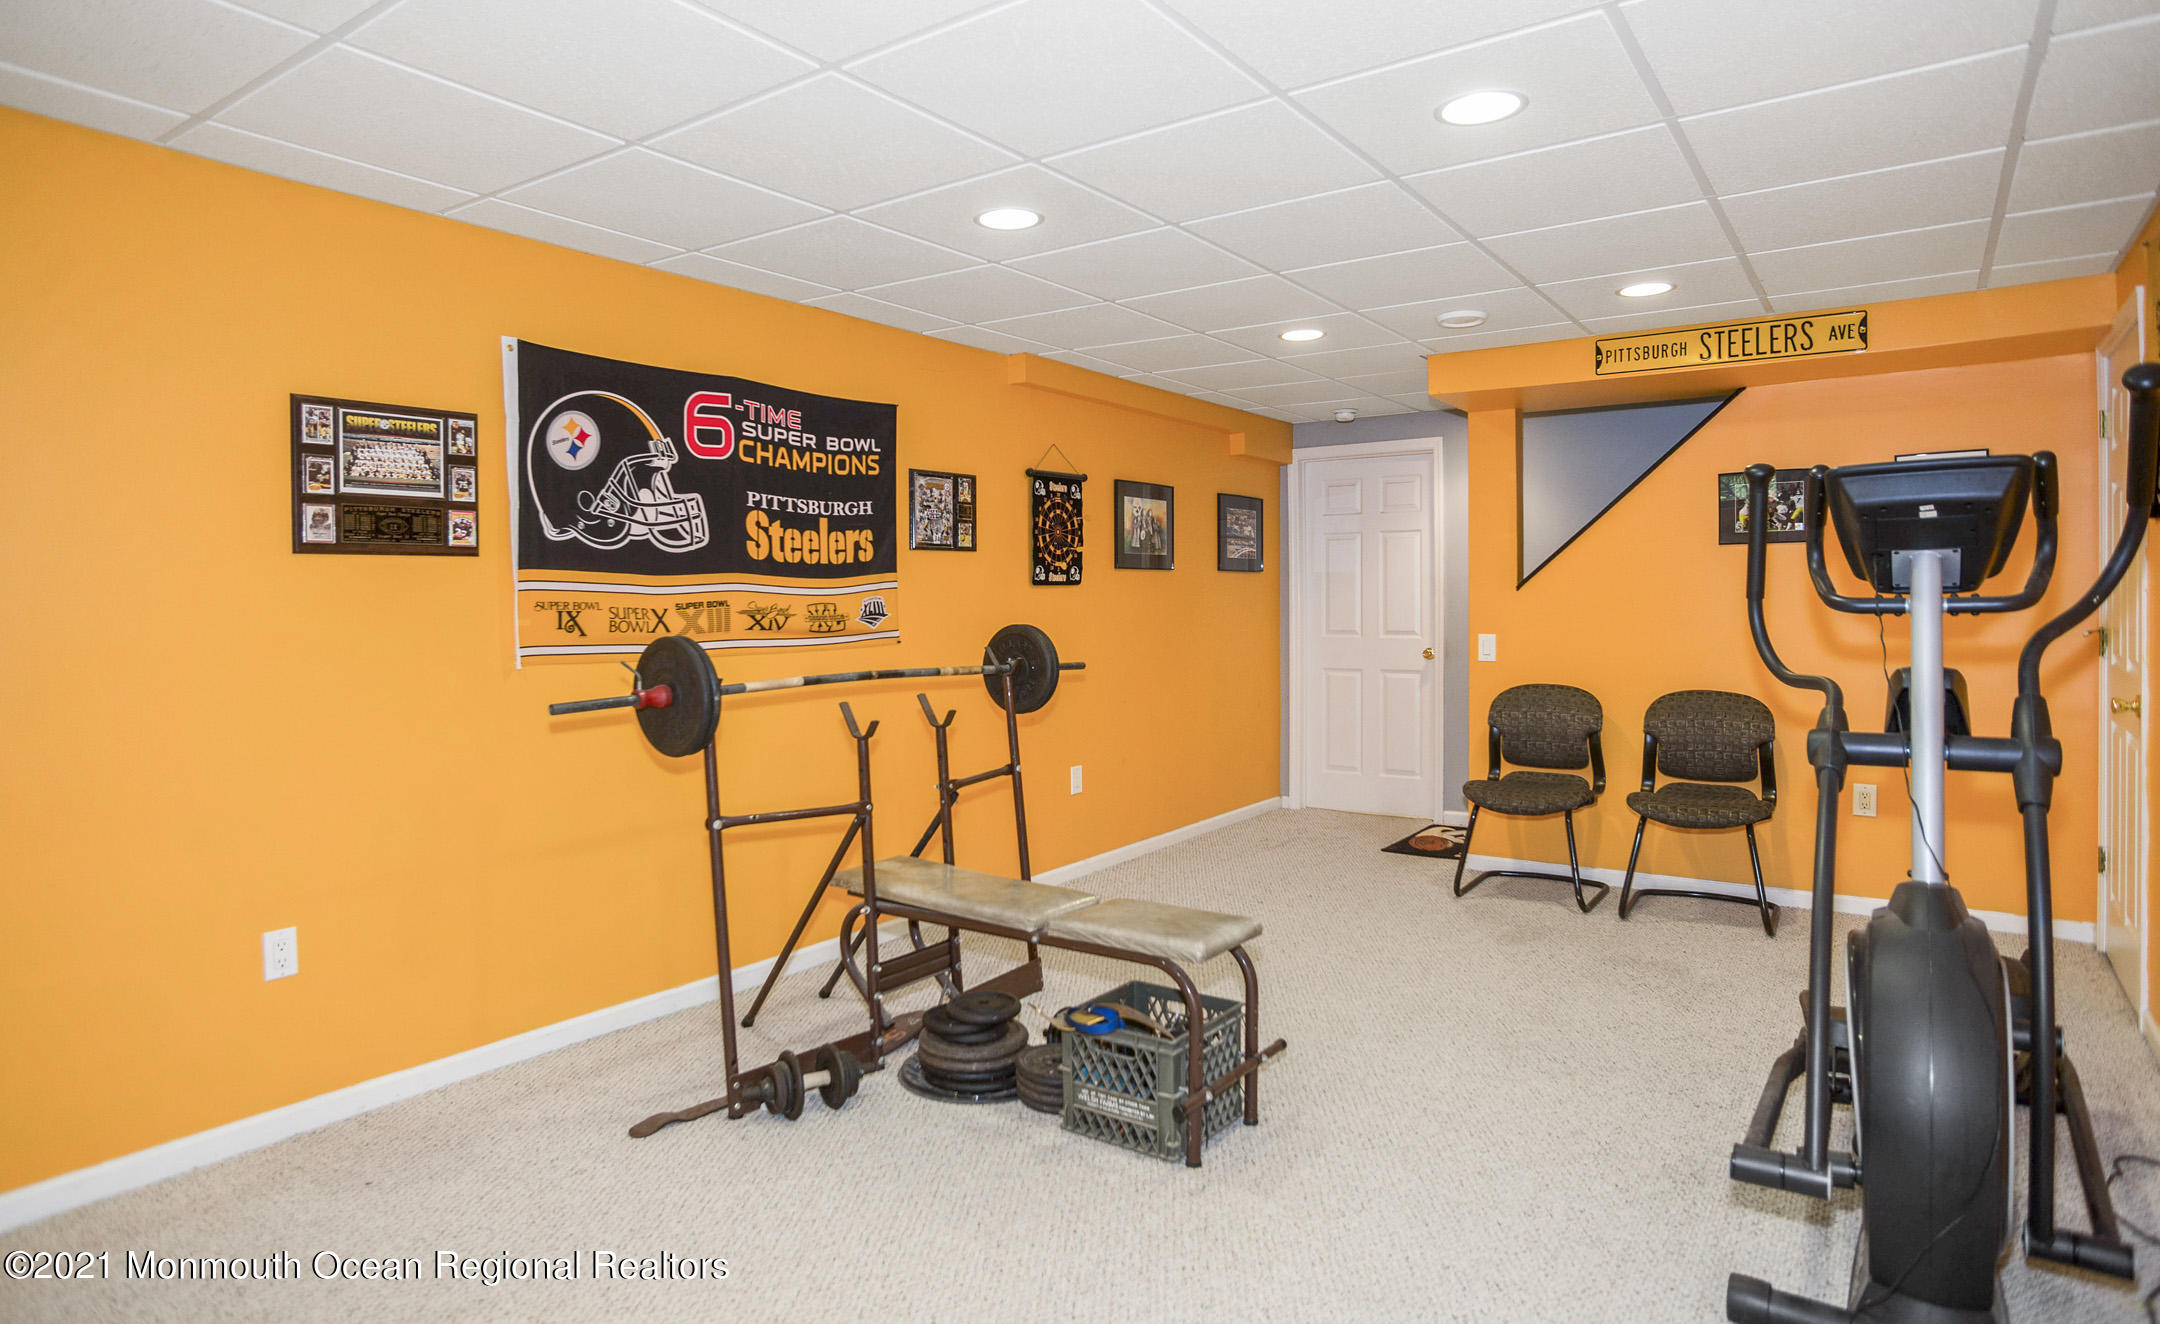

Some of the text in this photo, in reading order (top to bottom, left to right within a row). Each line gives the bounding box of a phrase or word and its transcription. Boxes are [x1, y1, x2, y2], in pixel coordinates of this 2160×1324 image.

[1605, 320, 1856, 364] PITTSBURGH STEELERS AVE
[742, 421, 881, 452] SUPER BOWL
[738, 439, 881, 476] CHAMPIONS
[746, 491, 874, 516] PITTSBURGH
[745, 510, 874, 565] Steelers
[573, 601, 603, 611] BOWL
[609, 606, 651, 620] SUPER
[675, 600, 731, 611] SUPER BOWL
[609, 620, 653, 633] BOWL
